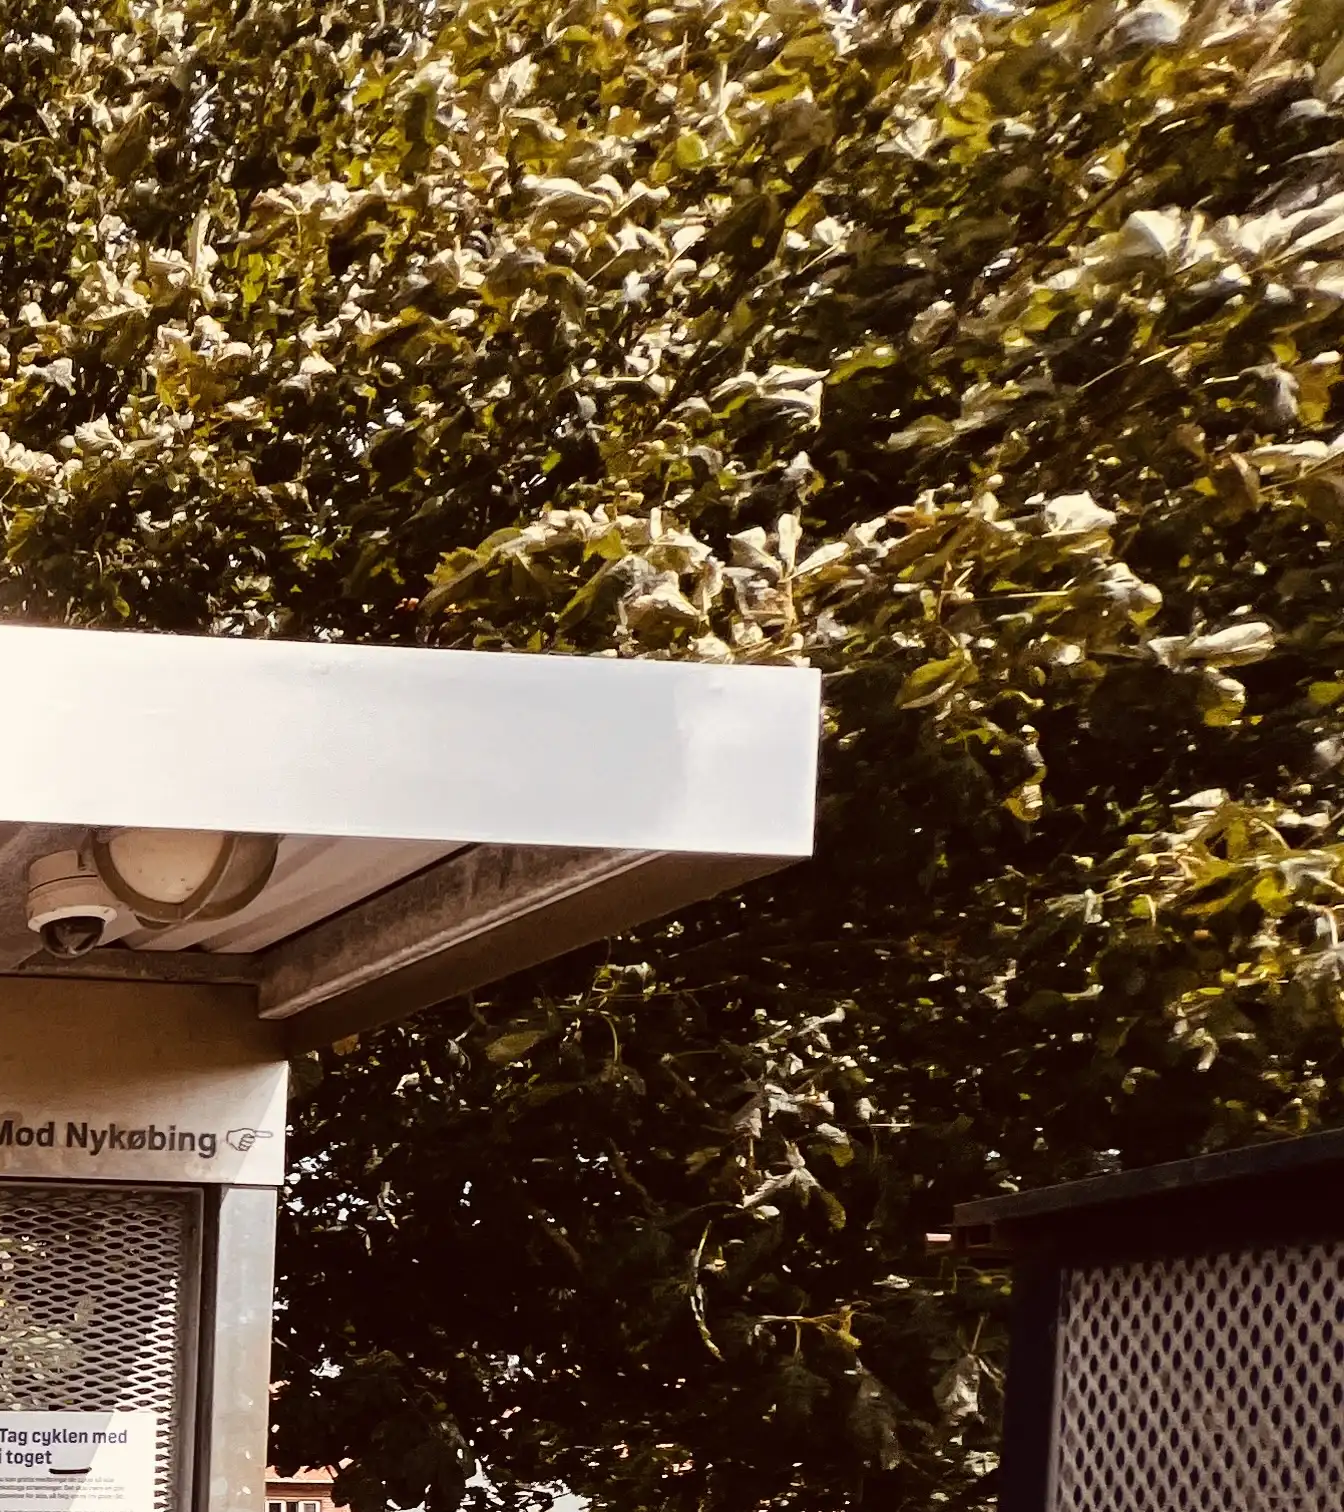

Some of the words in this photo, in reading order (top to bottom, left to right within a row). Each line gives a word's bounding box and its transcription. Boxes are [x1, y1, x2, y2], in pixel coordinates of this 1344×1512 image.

[66, 1122, 217, 1158] Nykøbing
[32, 1428, 88, 1447] cyklen
[92, 1429, 128, 1444] med
[5, 1450, 53, 1468] toget
